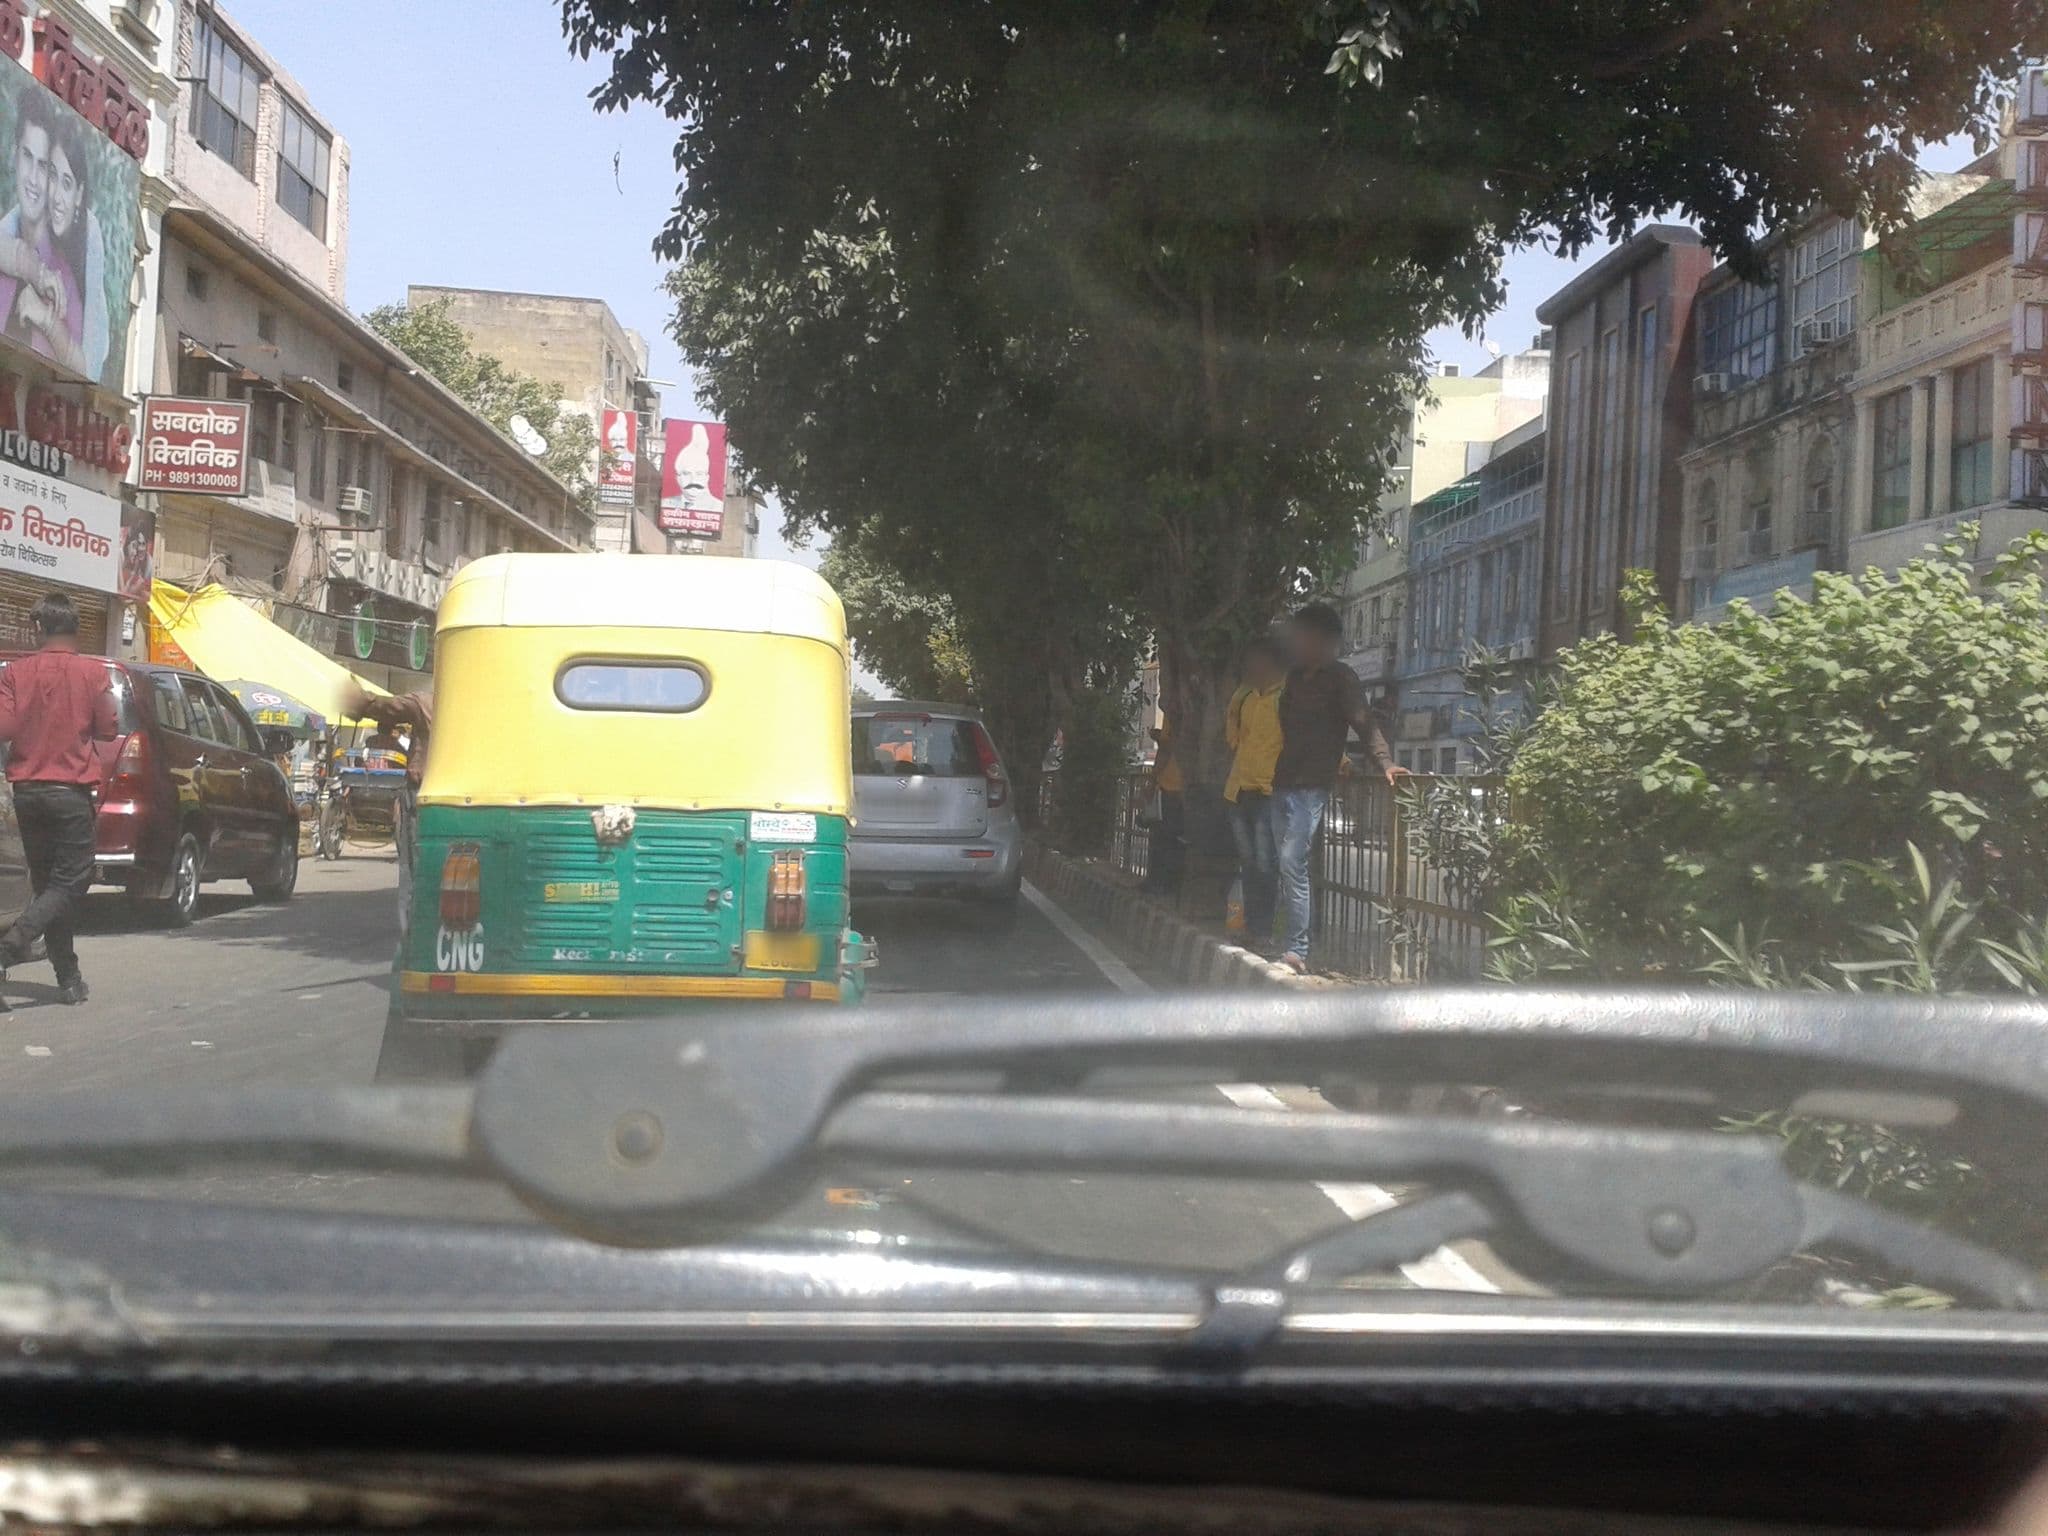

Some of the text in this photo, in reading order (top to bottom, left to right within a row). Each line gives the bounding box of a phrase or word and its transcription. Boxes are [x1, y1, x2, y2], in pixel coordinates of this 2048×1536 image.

[152, 407, 240, 435] सबलोक
[0, 427, 74, 479] LOGIST
[148, 436, 240, 468] क्लिनिक
[169, 471, 238, 488] 9891300008
[22, 504, 112, 557] क्लिनिक
[437, 922, 484, 971] CNG
